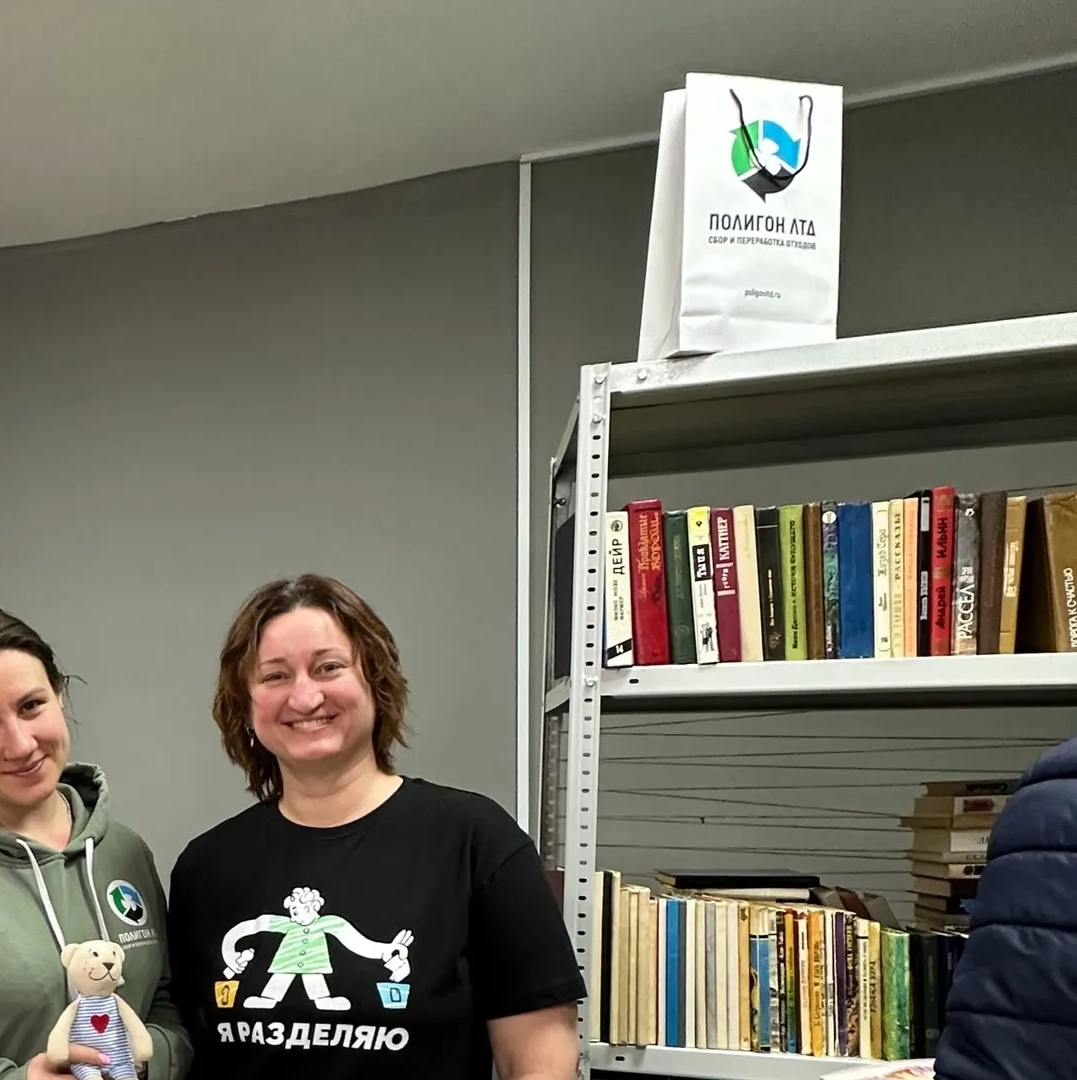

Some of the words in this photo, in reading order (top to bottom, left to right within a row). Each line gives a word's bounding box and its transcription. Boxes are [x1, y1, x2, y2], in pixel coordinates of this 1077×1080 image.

[708, 236, 727, 245] СБОР
[737, 236, 785, 247] ПЕРЕРАБОТКА
[786, 240, 816, 250] ОТХОДОВ
[709, 213, 785, 234] ПОЛИГОН
[789, 218, 816, 237] ЛТД
[611, 538, 626, 575] ДЕЙР
[717, 516, 731, 561] КАТТНЕР
[936, 517, 949, 559] ИЛЬИН
[1063, 568, 1076, 608] СЧАСТЬЮ
[935, 586, 947, 629] Андрей
[217, 1022, 235, 1042] Я
[237, 1021, 410, 1051] РАЗДЕЛЯЮ
